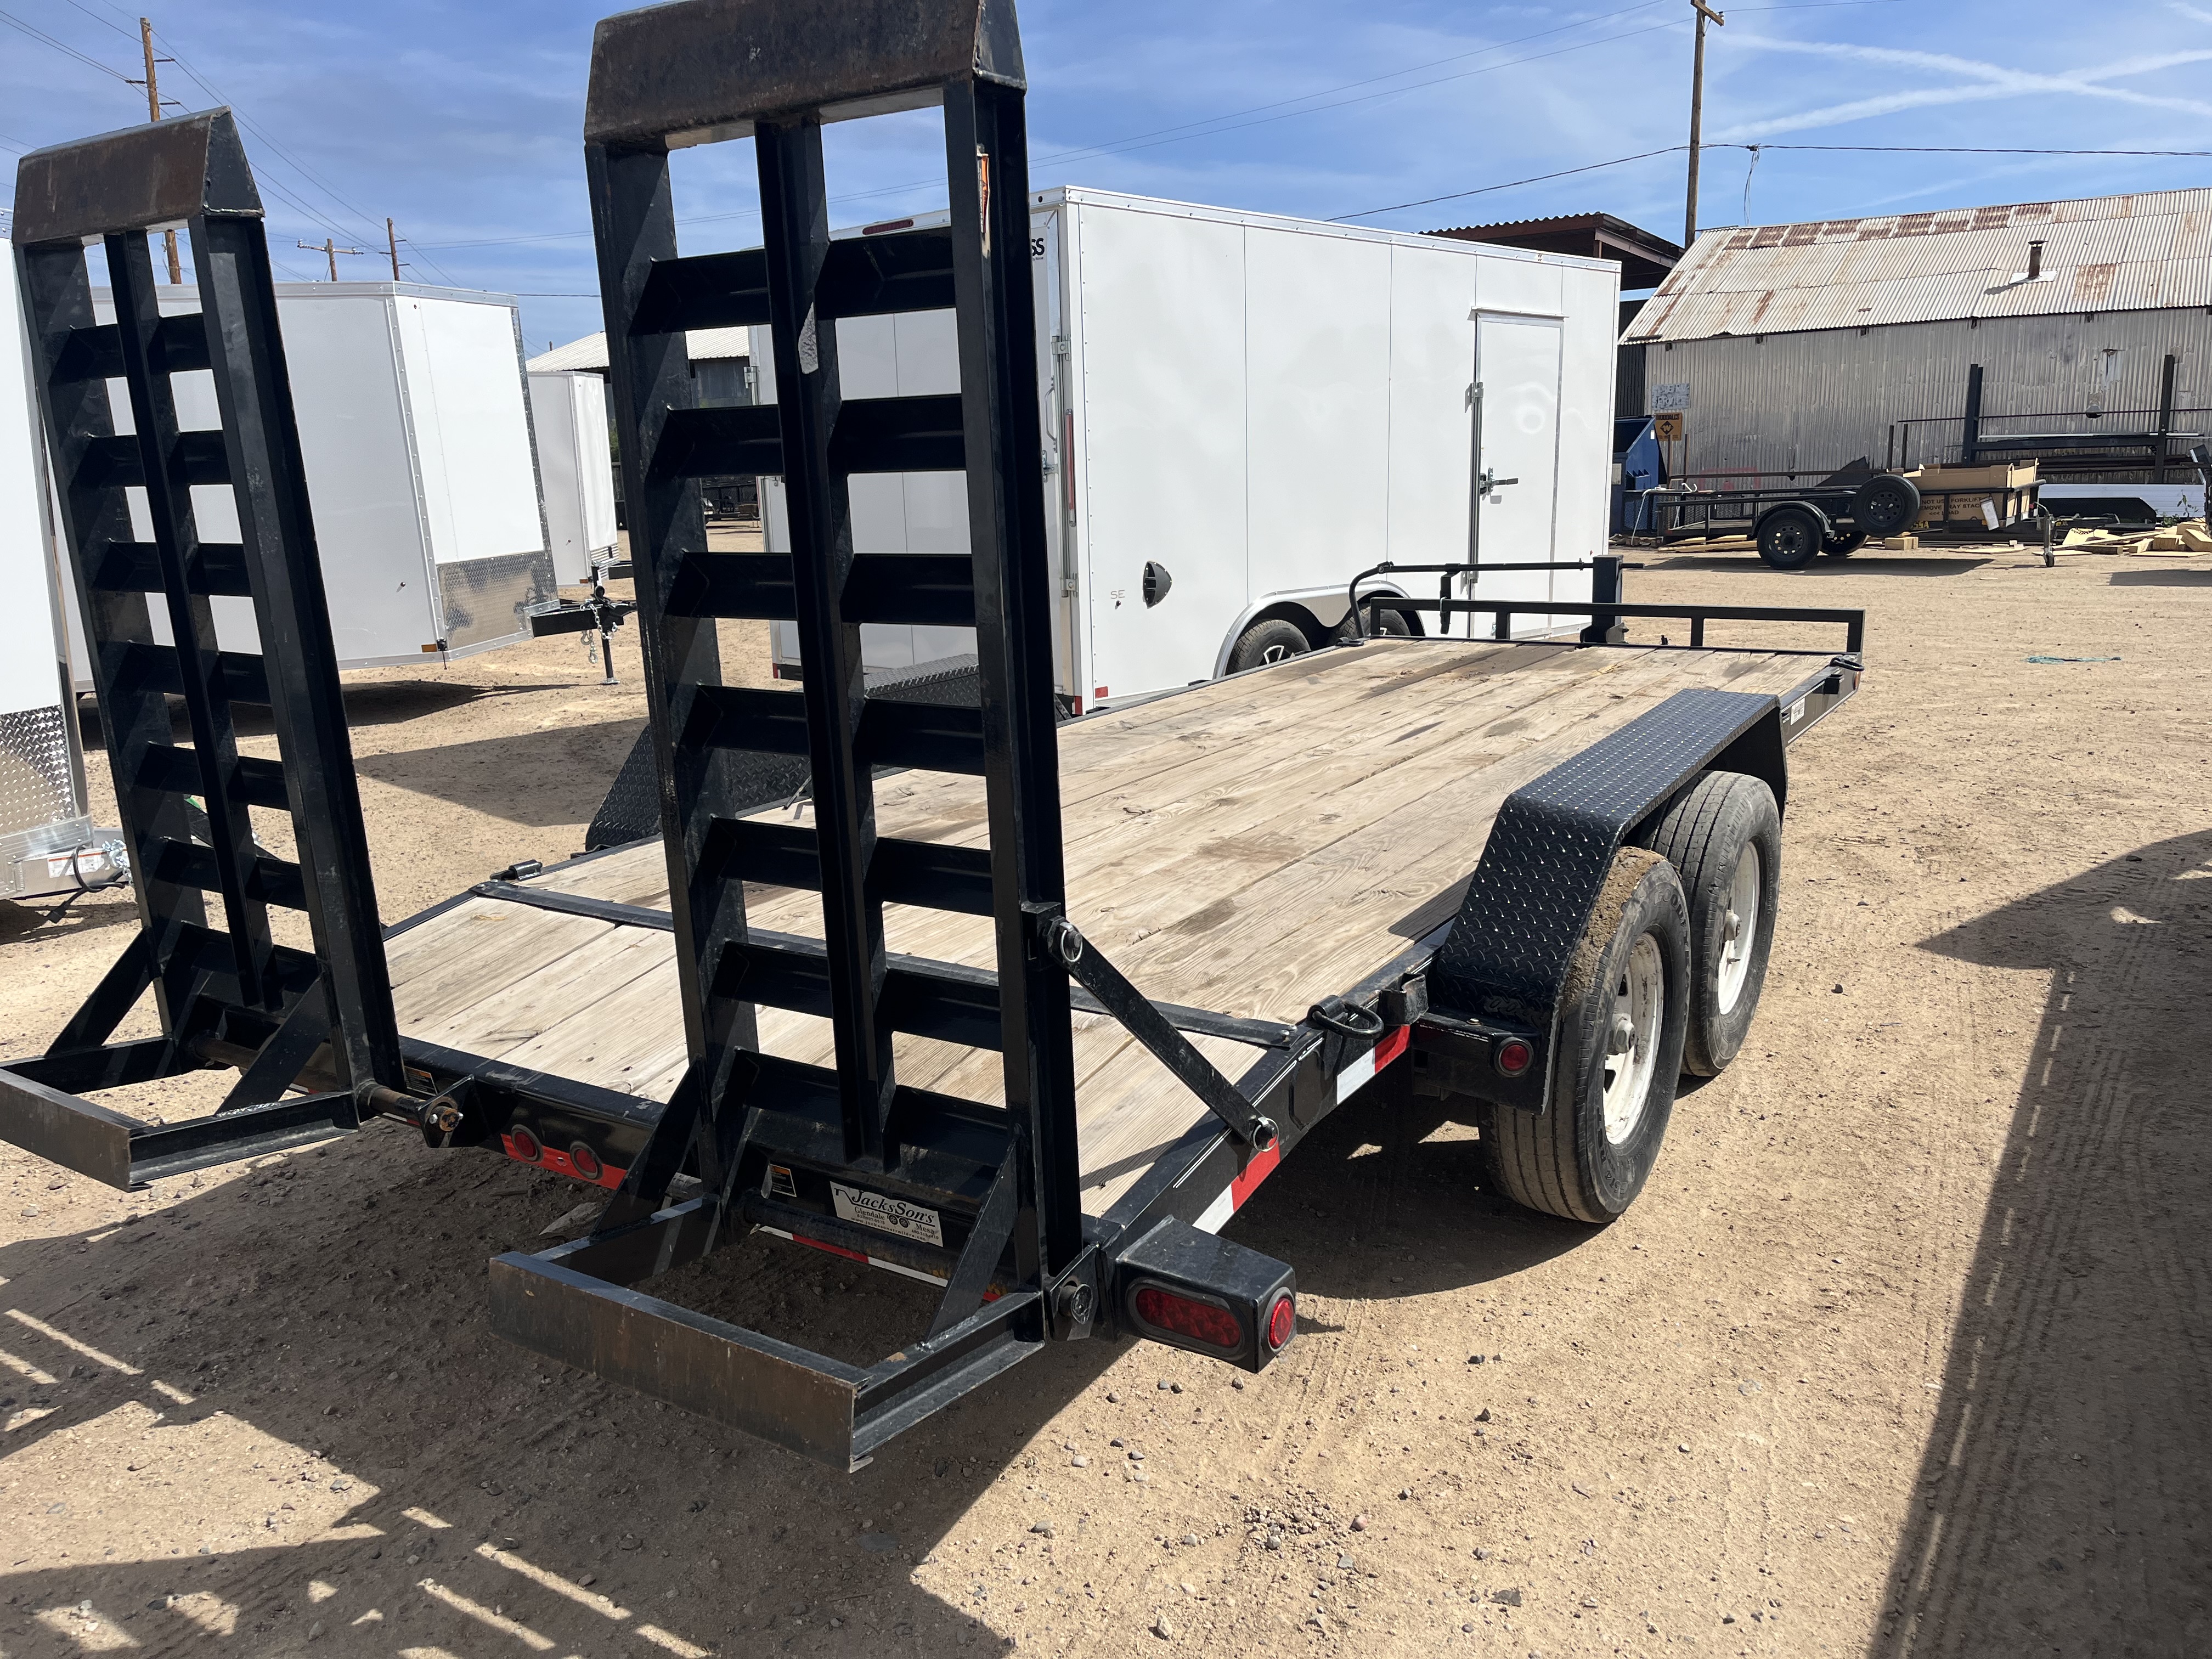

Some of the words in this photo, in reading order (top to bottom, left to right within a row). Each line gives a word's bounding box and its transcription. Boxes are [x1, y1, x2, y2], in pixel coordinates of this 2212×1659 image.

[1110, 589, 1126, 600] SE
[851, 1189, 934, 1223] JacksSon's
[854, 1206, 885, 1220] Glendale
[915, 1223, 935, 1234] Mesa
